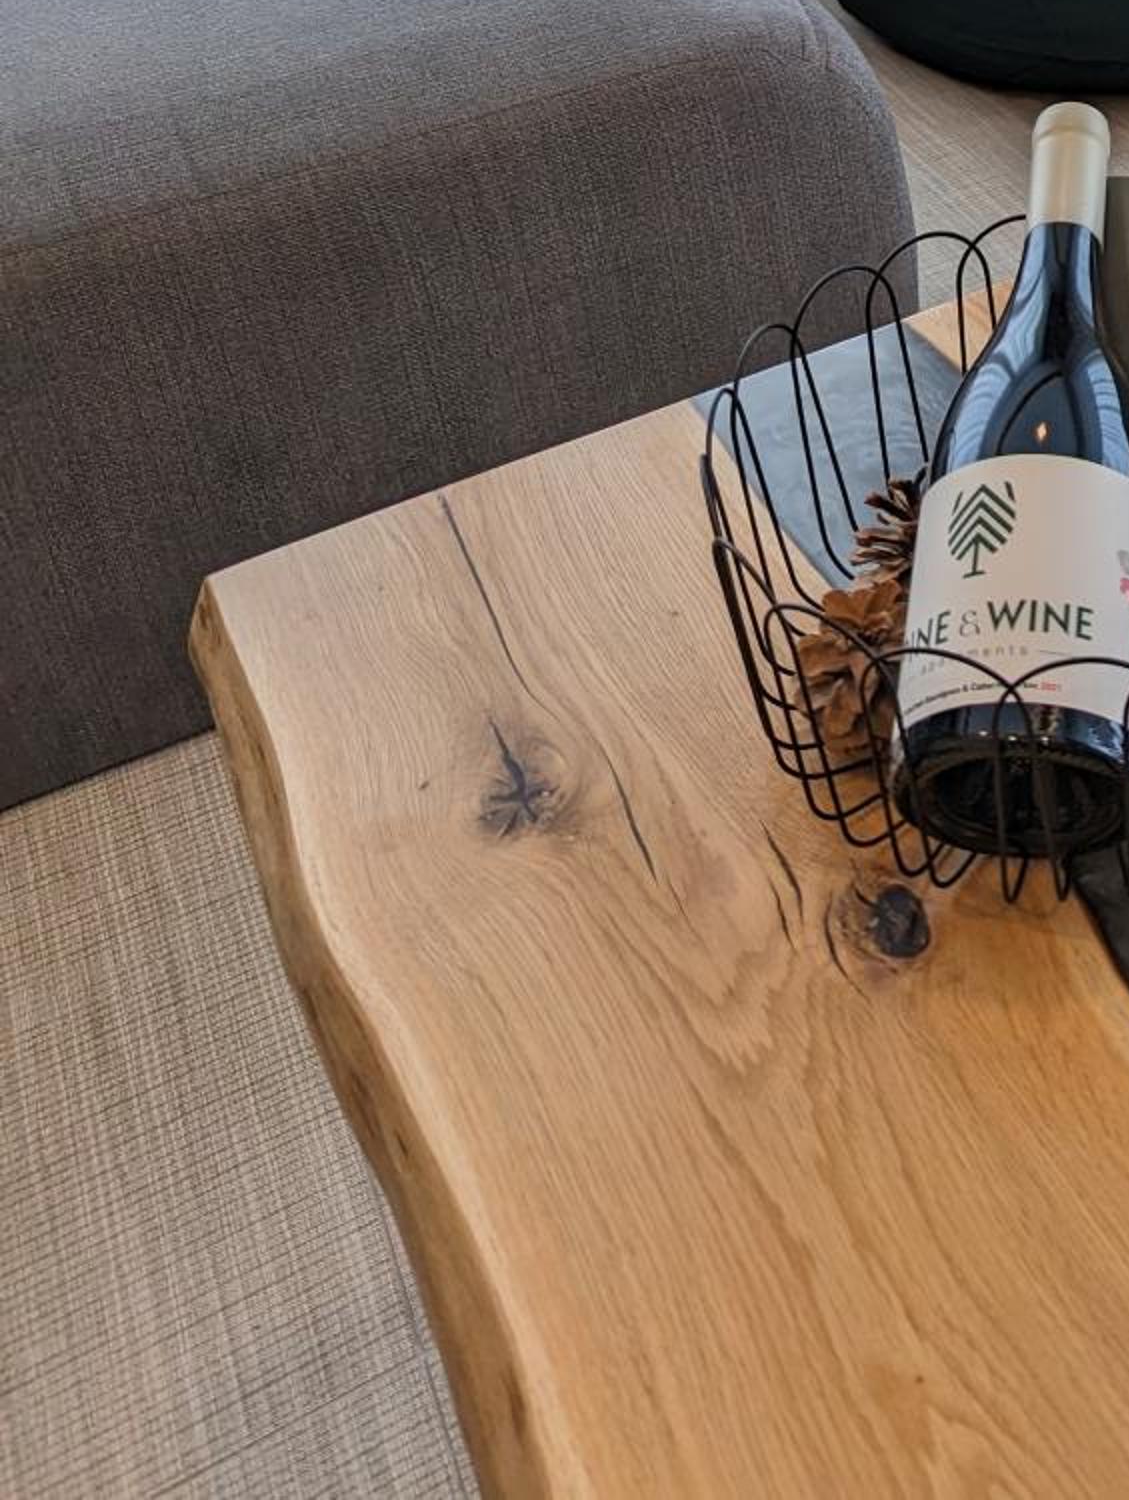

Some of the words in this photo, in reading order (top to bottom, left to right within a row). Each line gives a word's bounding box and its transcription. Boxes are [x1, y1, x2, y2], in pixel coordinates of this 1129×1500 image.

[905, 610, 951, 662] INE
[959, 609, 980, 637] &
[987, 599, 1093, 641] WINE
